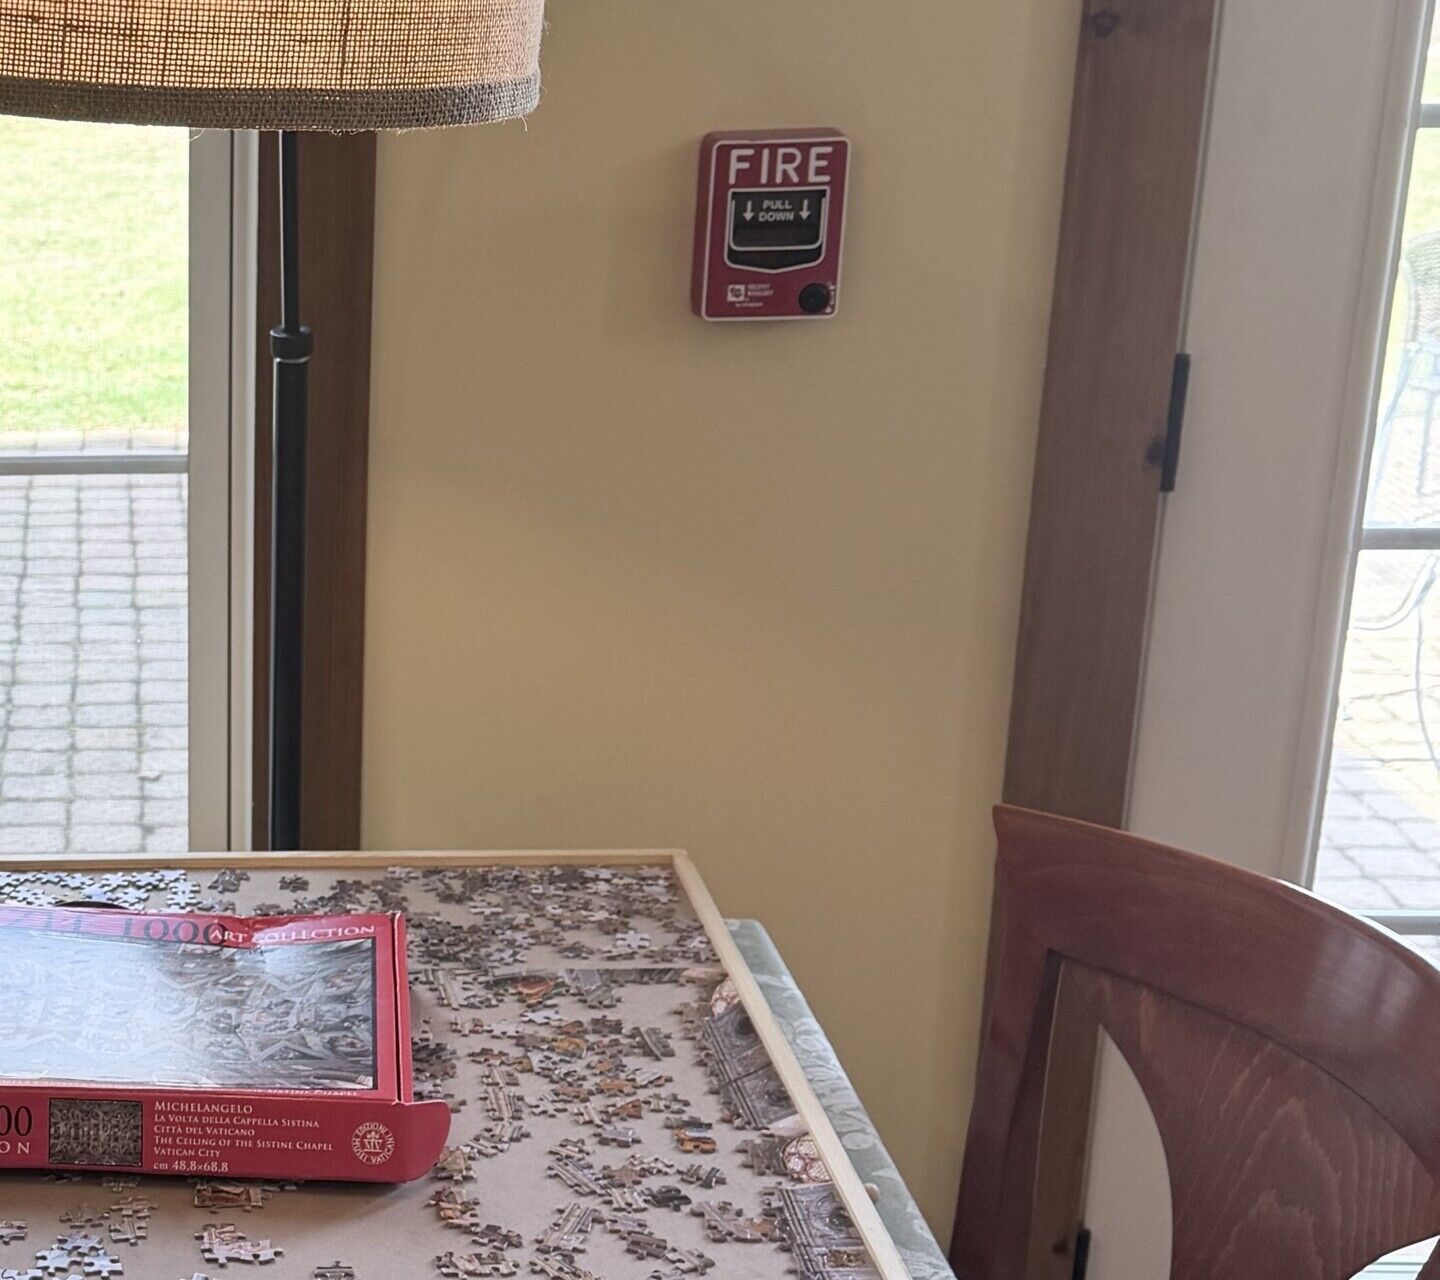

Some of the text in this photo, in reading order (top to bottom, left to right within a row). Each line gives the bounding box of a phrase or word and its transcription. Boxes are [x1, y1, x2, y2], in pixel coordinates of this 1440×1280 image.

[728, 146, 833, 184] FIRE
[762, 200, 792, 210] PULL
[758, 211, 795, 222] DOWN
[210, 925, 375, 943] ART COLLECTION
[155, 1101, 253, 1114] MICHELANGELO
[155, 1114, 320, 1128] LA VOLTA DELLA CAPPELLA SISTINA
[206, 1126, 255, 1136] VATICANO
[155, 1136, 333, 1151] THE CEILING OF THE SISTINE CHAPEL
[154, 1147, 221, 1157] VATICAN CITY
[153, 1162, 168, 1170] cm
